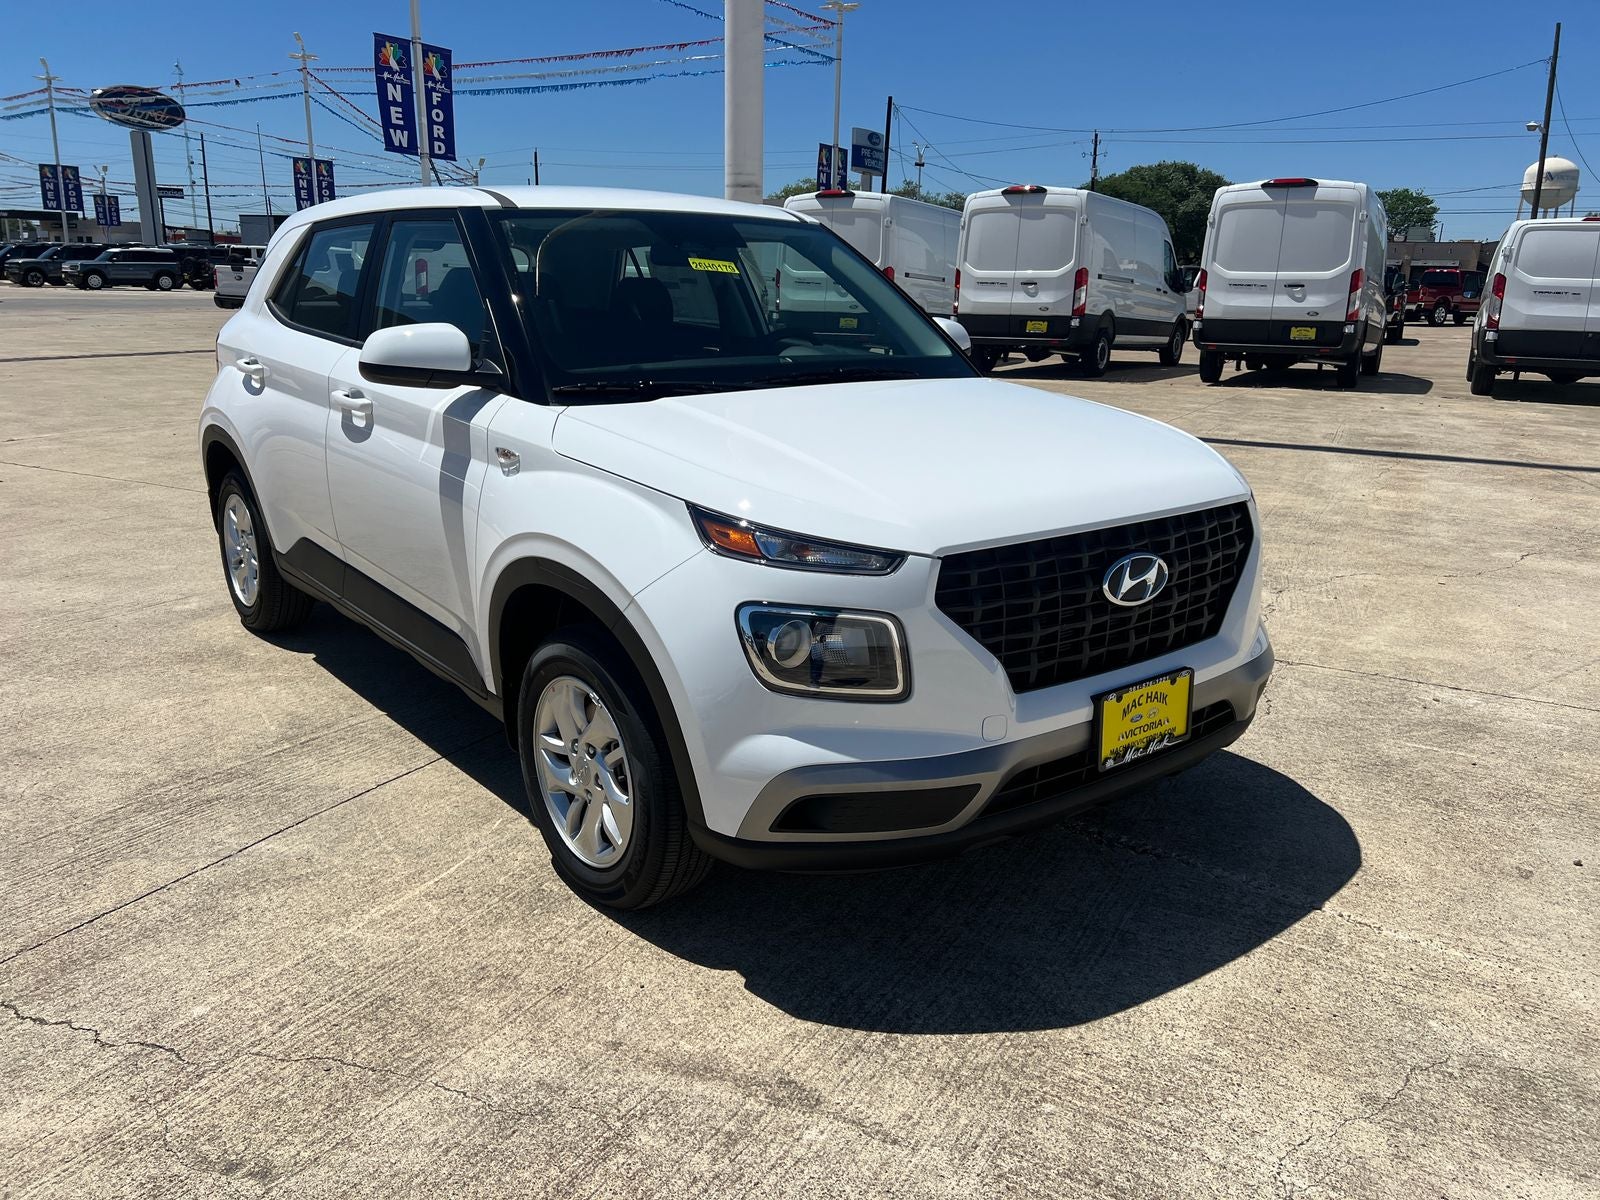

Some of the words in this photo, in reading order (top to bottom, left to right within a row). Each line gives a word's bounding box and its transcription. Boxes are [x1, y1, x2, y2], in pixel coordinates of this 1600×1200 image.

[387, 83, 409, 148] NEW
[431, 91, 446, 155] FORD
[45, 182, 57, 209] NEW
[68, 183, 78, 210] FORD
[299, 179, 311, 209] NEW
[321, 181, 330, 202] FOR
[1121, 694, 1144, 721] MAC
[1145, 690, 1168, 706] HAIK
[1124, 718, 1163, 740] VICTORIA
